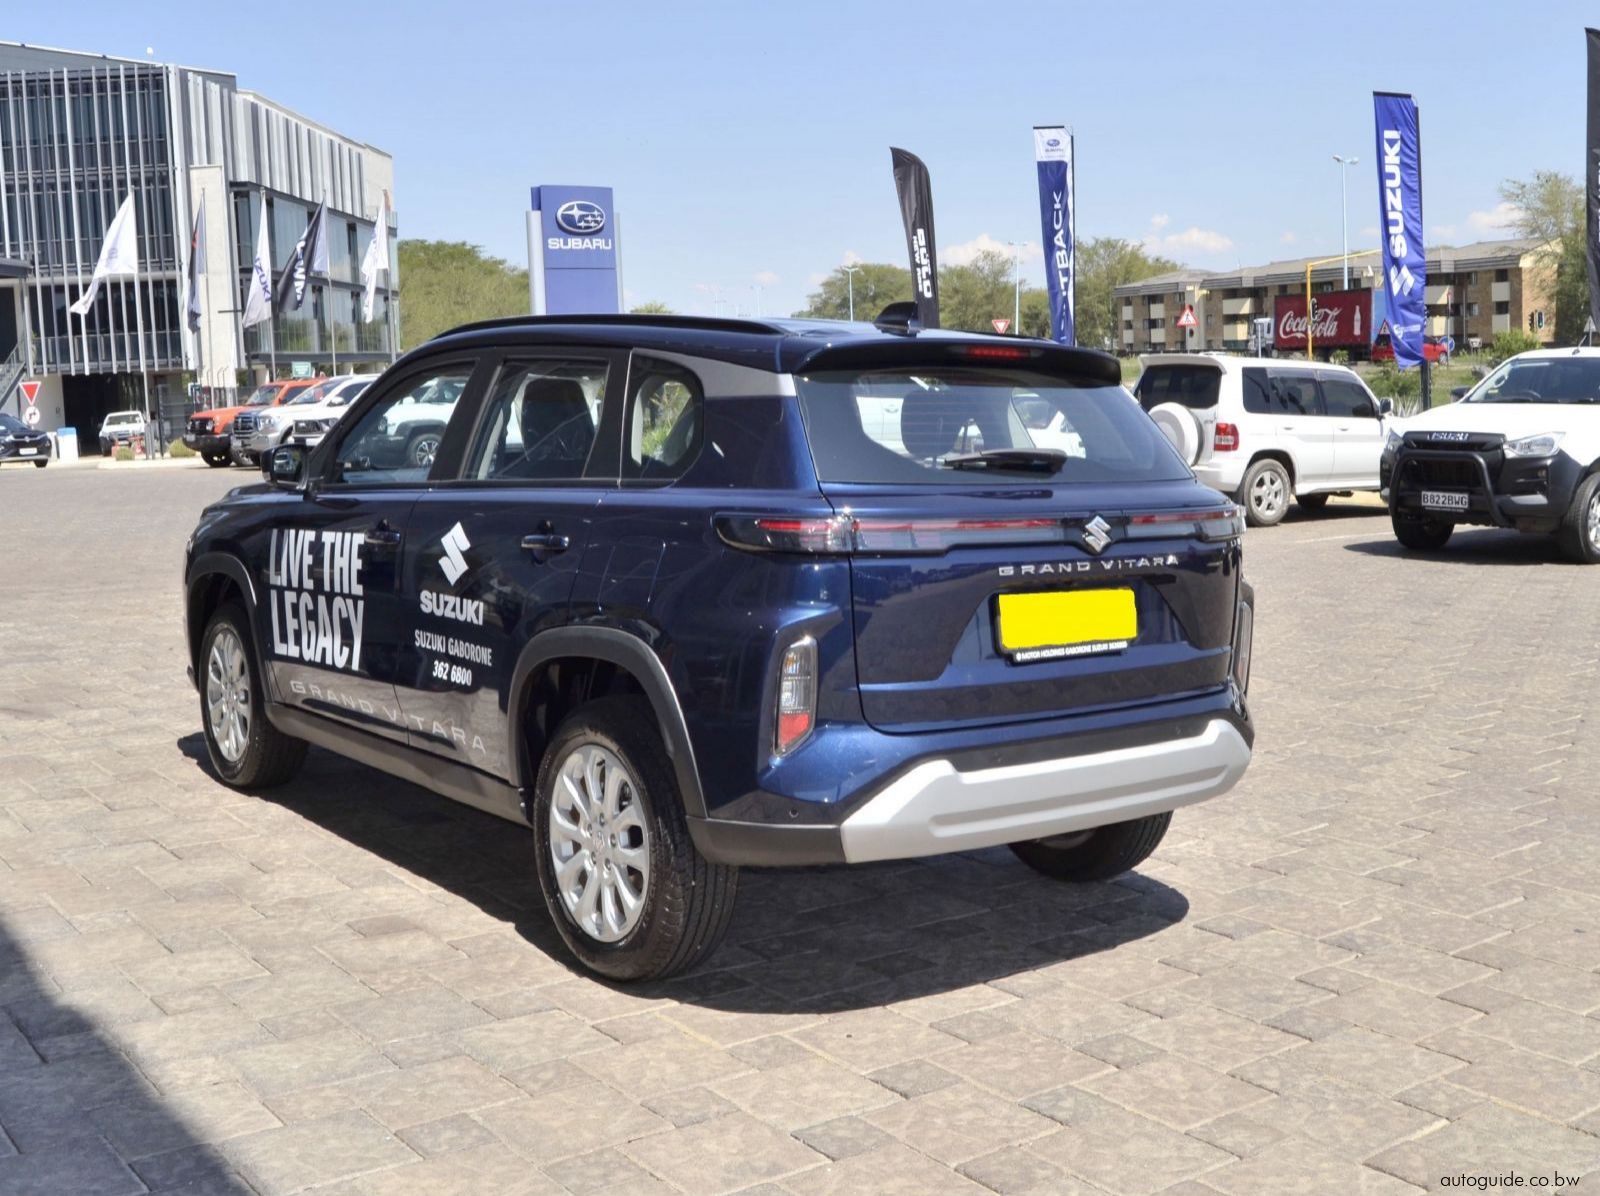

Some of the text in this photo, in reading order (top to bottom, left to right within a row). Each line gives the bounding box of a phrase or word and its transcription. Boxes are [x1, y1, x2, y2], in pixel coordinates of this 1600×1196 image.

[1383, 129, 1407, 258] SUZUKI
[547, 237, 612, 250] SUBARU
[1053, 191, 1070, 332] TBACK
[1422, 491, 1468, 508] B822BWG
[269, 528, 365, 597] LIVE THE
[998, 554, 1179, 576] GRAND VITARA
[419, 590, 484, 626] SUZUKI
[270, 589, 364, 671] LEGACY
[414, 629, 493, 667] SUZUKI GABORONE
[432, 660, 473, 687] 362 6800
[290, 679, 488, 754] GRAND VITARA
